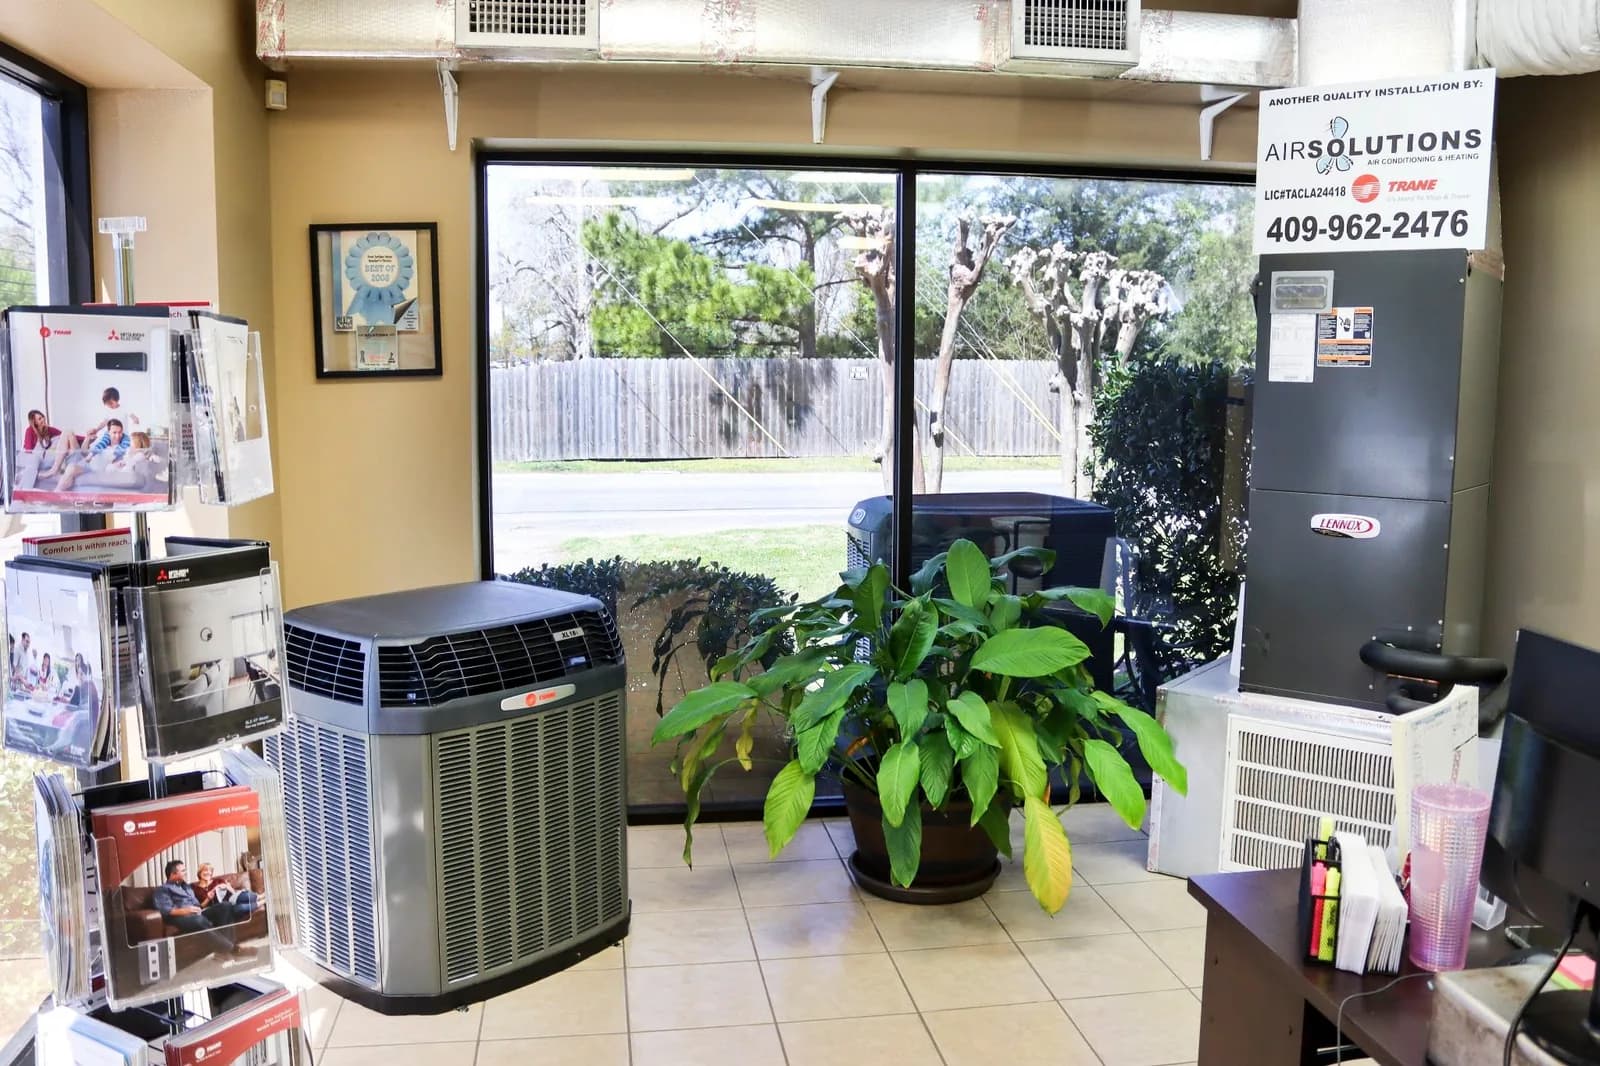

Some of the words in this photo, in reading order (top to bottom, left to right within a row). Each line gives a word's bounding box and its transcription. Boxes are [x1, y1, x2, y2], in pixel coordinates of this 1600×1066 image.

[1269, 94, 1320, 106] ANOTHER
[1323, 89, 1371, 101] QUALITY
[1375, 82, 1459, 97] INSTALLATION
[1463, 80, 1483, 89] BY:
[1381, 155, 1436, 165] CONDITIONING
[1445, 153, 1479, 161] HEATING
[1388, 179, 1438, 192] TRANE
[1264, 186, 1346, 201] LIC#TACLA24418
[1266, 209, 1469, 243] 409-962-2476
[1320, 518, 1362, 530] LENNOX
[42, 545, 75, 556] Comfort
[76, 543, 82, 552] is
[84, 541, 107, 551] within
